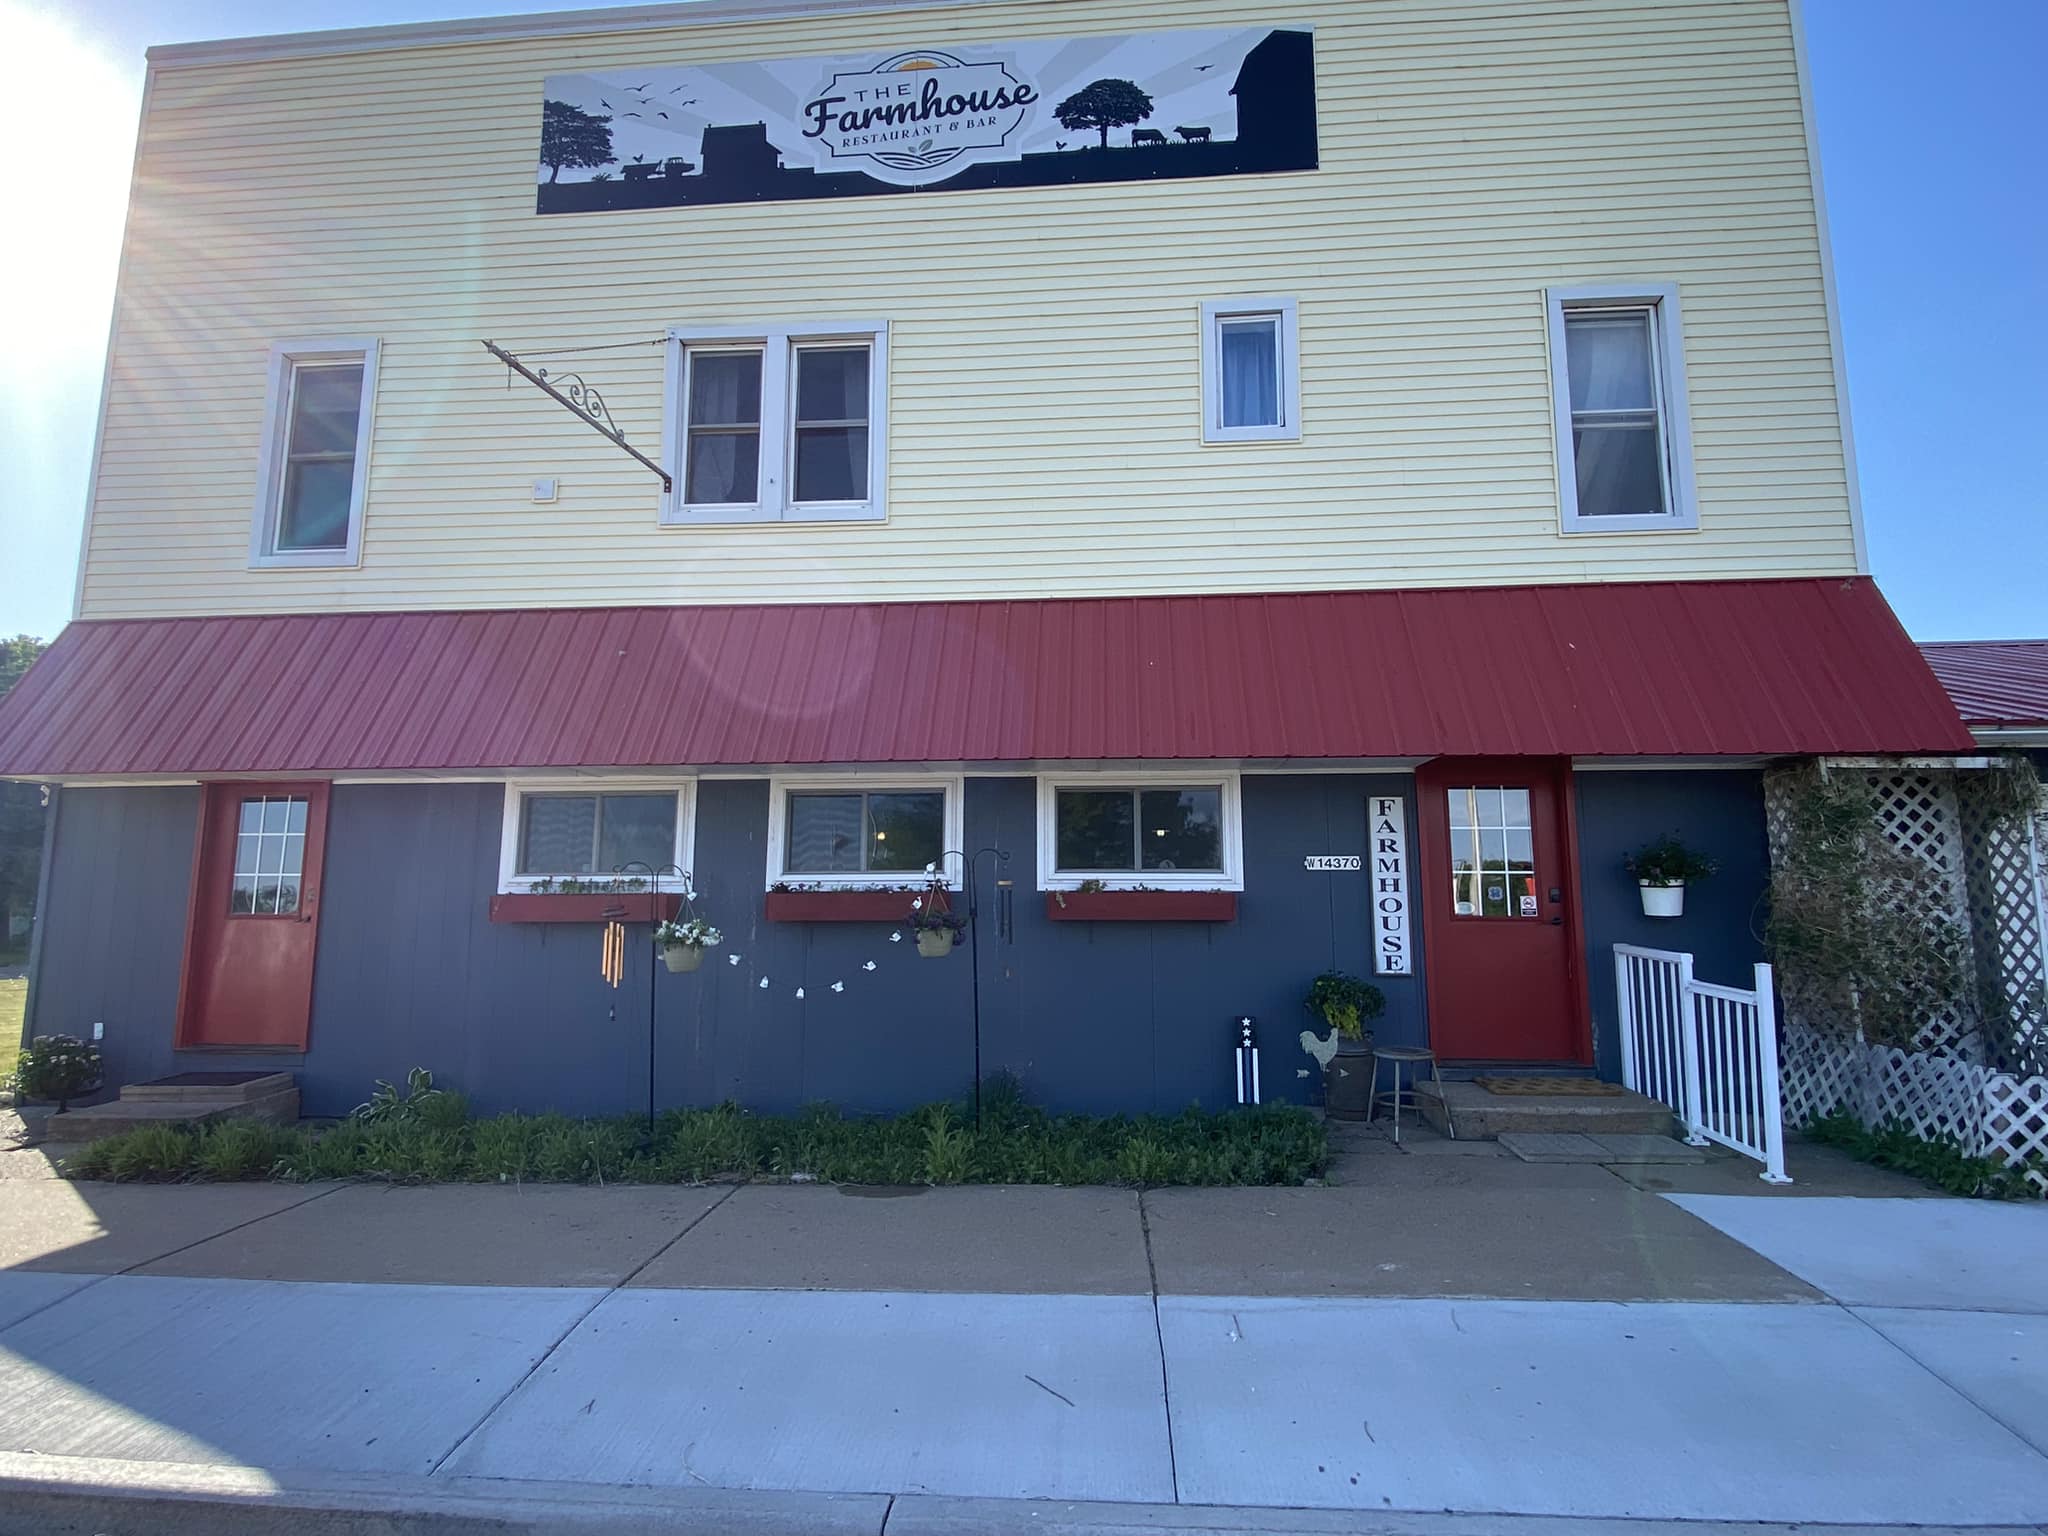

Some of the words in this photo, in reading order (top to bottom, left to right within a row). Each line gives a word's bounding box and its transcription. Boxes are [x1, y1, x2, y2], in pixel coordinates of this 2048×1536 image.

[802, 77, 1039, 138] Farmhouse
[854, 83, 911, 102] THE
[842, 124, 942, 148] RESTAURANT
[949, 121, 959, 131] &
[966, 116, 997, 129] BAR
[1376, 799, 1404, 972] FARMHOUSE
